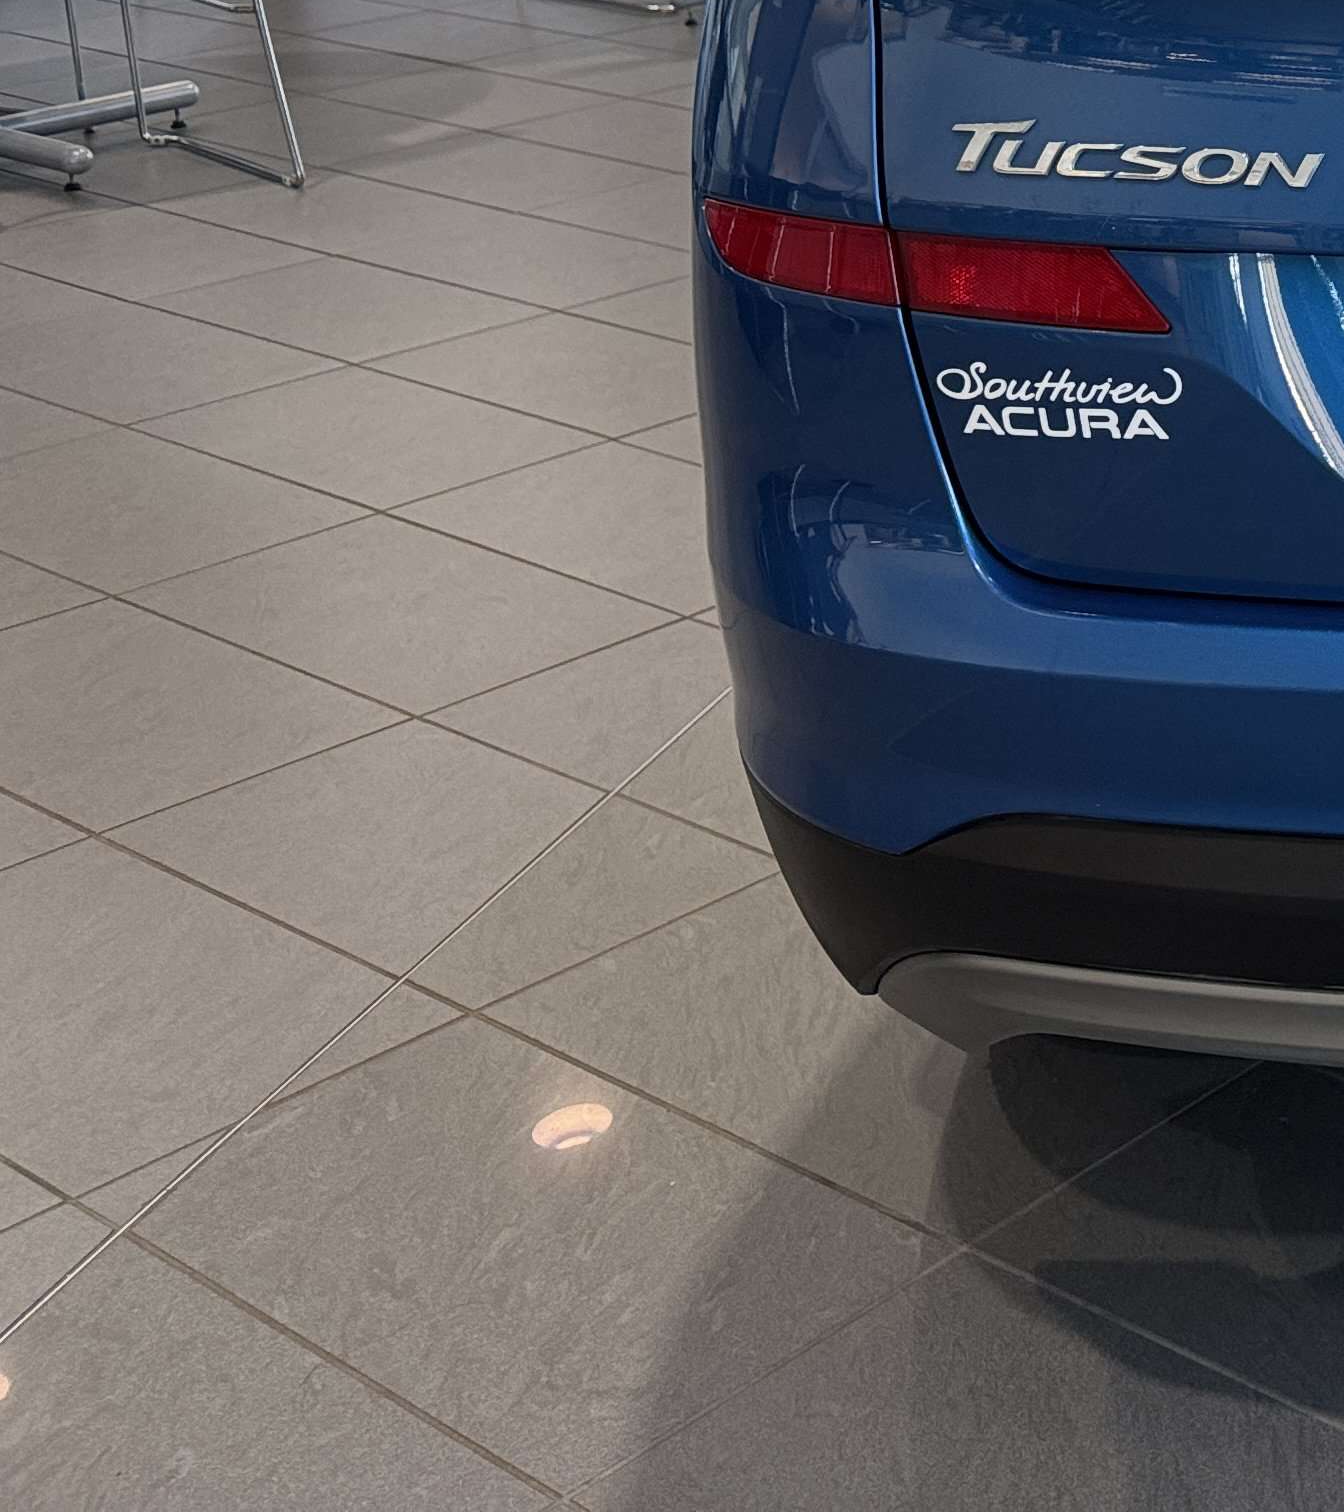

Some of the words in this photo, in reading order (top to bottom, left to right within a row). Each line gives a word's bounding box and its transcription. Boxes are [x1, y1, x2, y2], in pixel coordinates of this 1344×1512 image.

[951, 118, 1326, 188] TUCSON
[936, 361, 1183, 405] Southview
[963, 404, 1170, 440] ACURA
